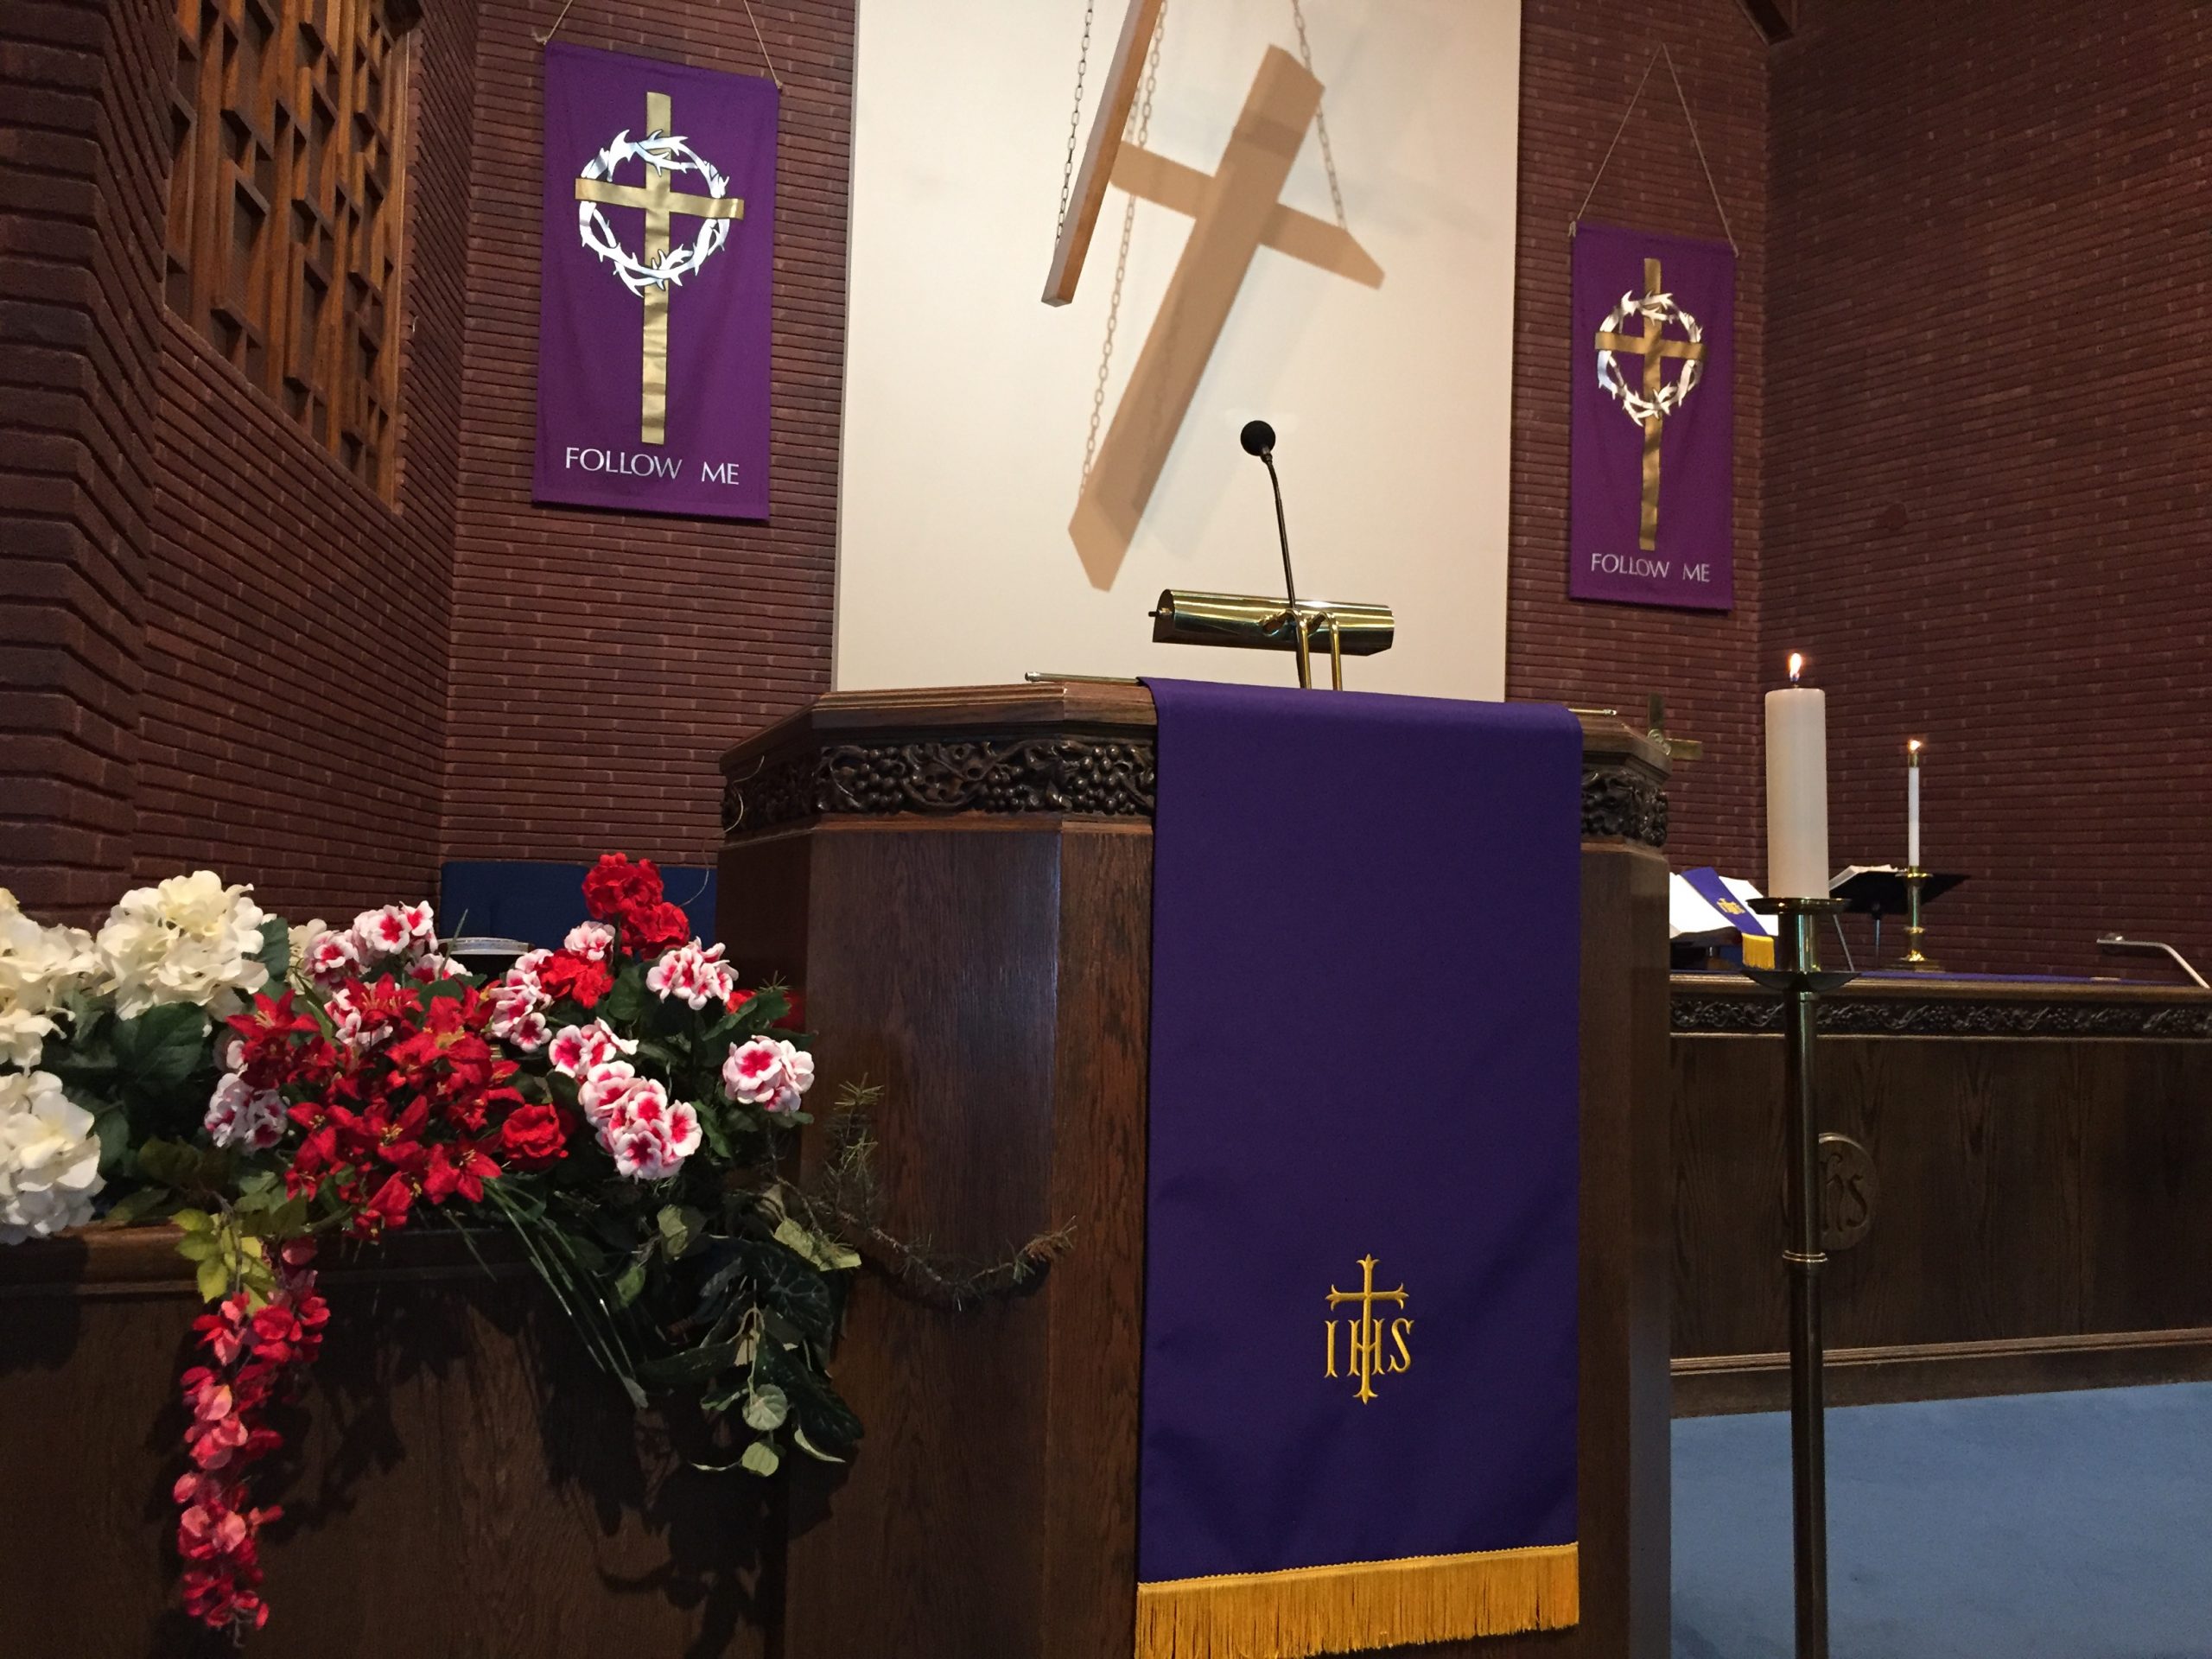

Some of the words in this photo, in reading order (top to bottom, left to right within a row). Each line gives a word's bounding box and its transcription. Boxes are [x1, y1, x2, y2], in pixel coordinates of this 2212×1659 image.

[565, 447, 683, 480] FOLLOW
[701, 461, 740, 485] ME
[1591, 553, 1670, 578] FOLLOW
[1682, 563, 1711, 582] ME
[1324, 1318, 1414, 1378] IHS
